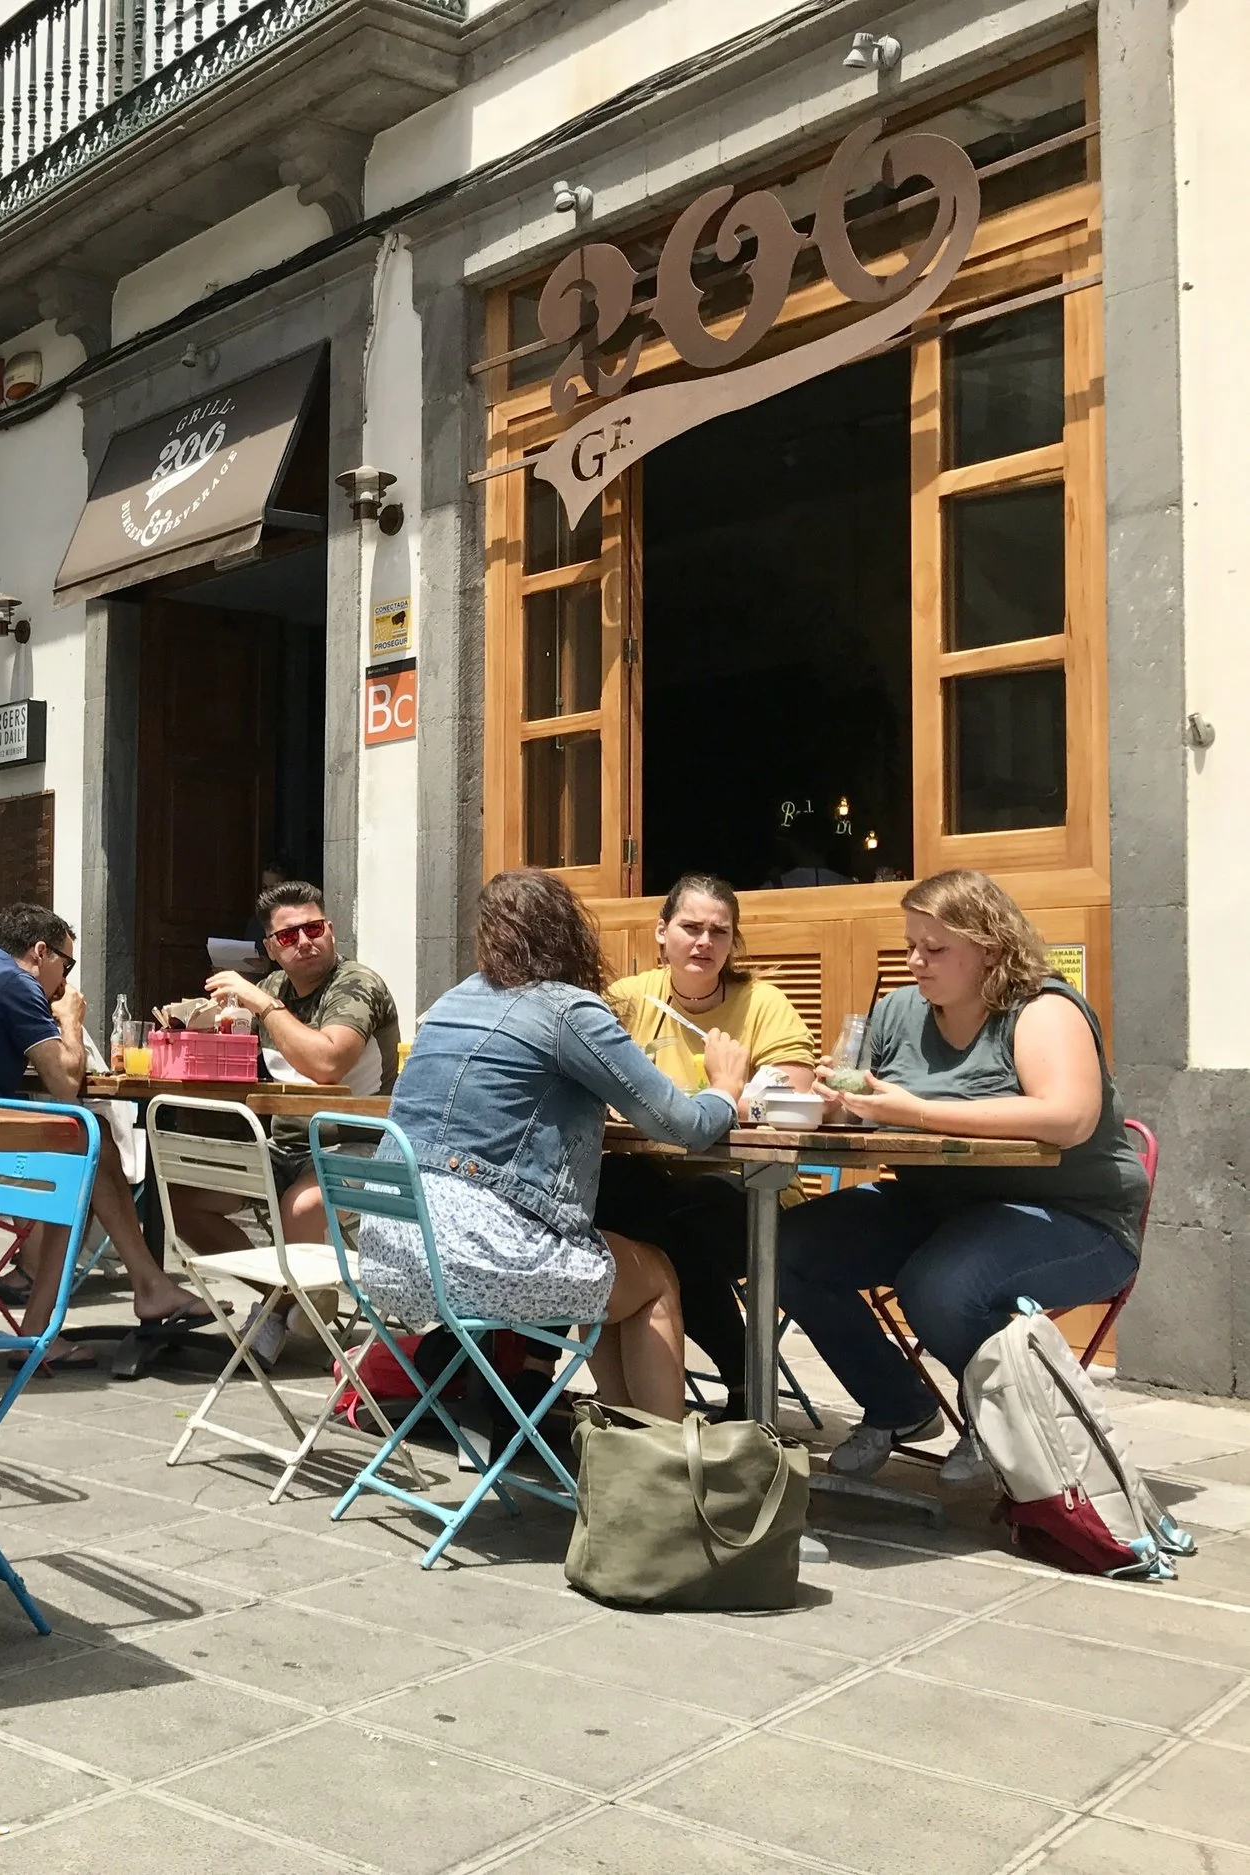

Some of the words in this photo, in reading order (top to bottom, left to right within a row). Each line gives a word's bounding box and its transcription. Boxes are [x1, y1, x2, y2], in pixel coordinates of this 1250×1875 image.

[538, 117, 981, 416] 200
[152, 420, 226, 481] 200
[121, 500, 143, 542] BURGER
[140, 509, 173, 547] &
[163, 450, 238, 534] BEVERAGE
[374, 600, 409, 614] CONECTADA
[374, 637, 408, 650] PROSEGUR
[367, 684, 414, 734] Bc
[4, 727, 26, 745] DAILY
